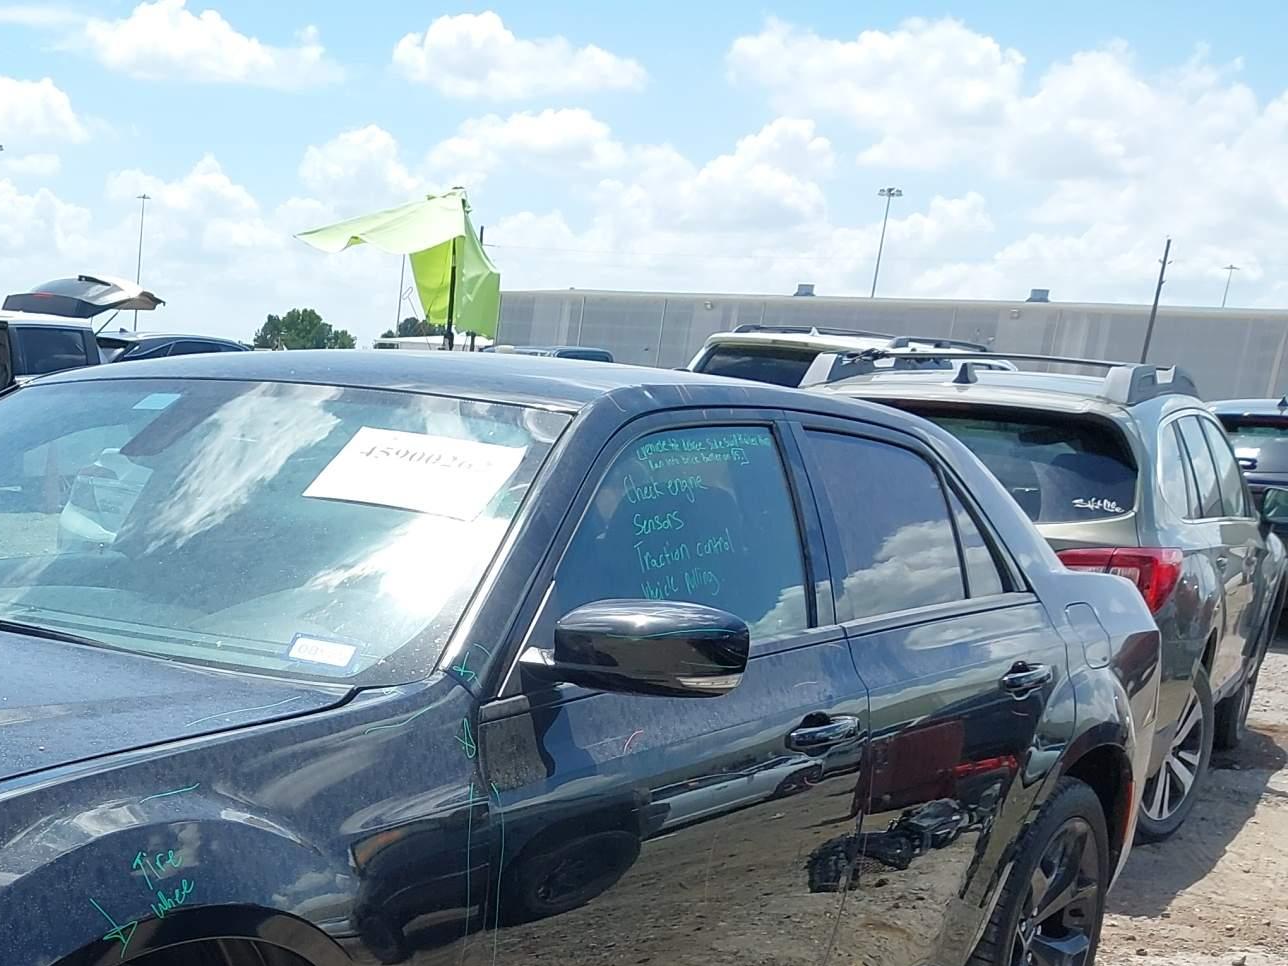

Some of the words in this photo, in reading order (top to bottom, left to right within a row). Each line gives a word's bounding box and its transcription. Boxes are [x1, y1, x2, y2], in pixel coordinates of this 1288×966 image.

[359, 445, 494, 473] 4590026
[633, 511, 684, 536] Sensors
[633, 540, 690, 573] Traction
[696, 528, 735, 557] control
